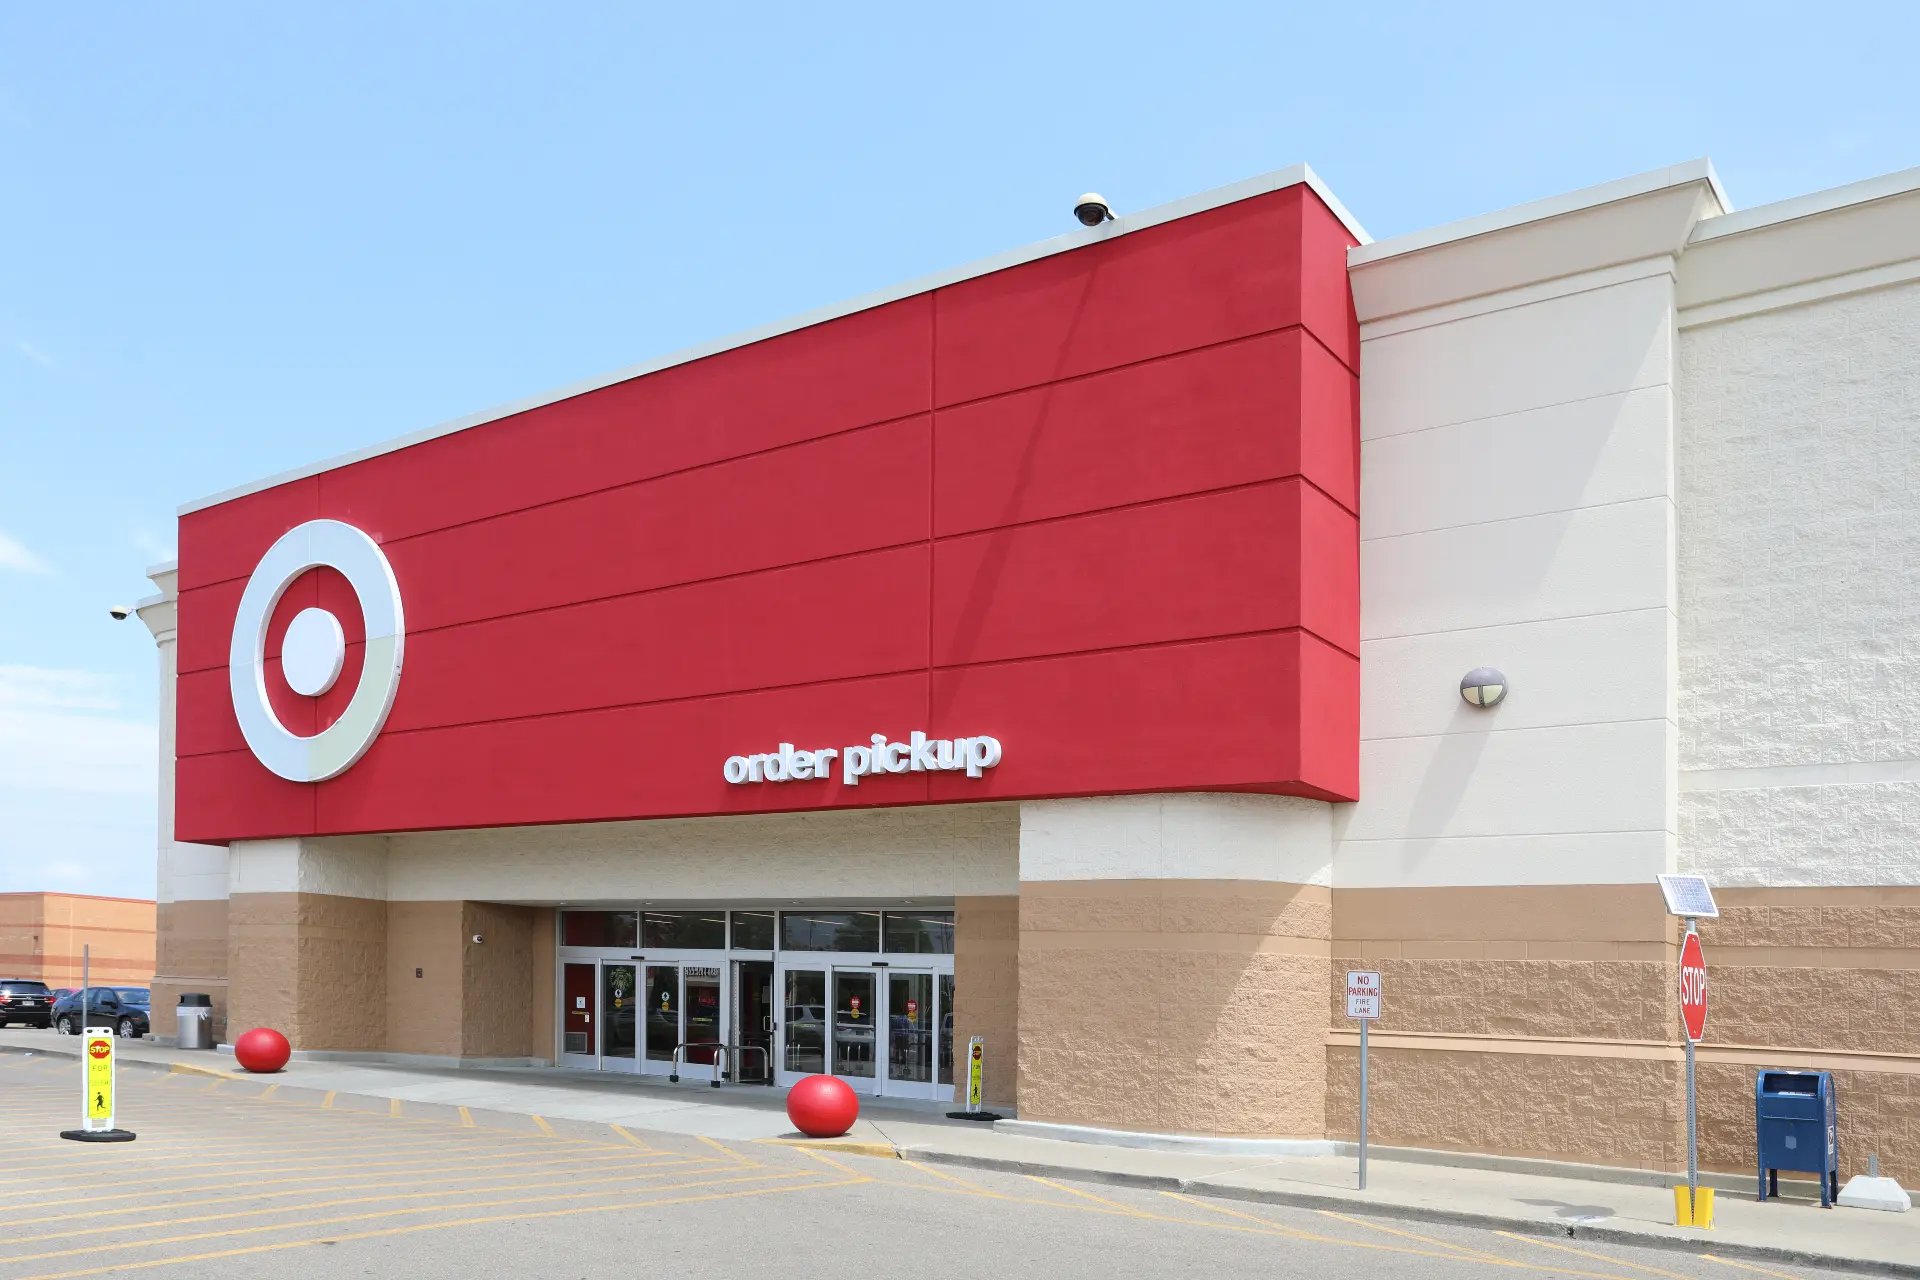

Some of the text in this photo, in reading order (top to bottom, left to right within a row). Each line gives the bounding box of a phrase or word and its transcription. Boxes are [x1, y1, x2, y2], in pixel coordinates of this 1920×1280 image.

[724, 731, 1002, 785] order pickup
[1357, 975, 1370, 985] NO
[1682, 966, 1705, 1005] STOP
[1348, 987, 1378, 996] PARKING
[90, 1045, 110, 1054] STOP
